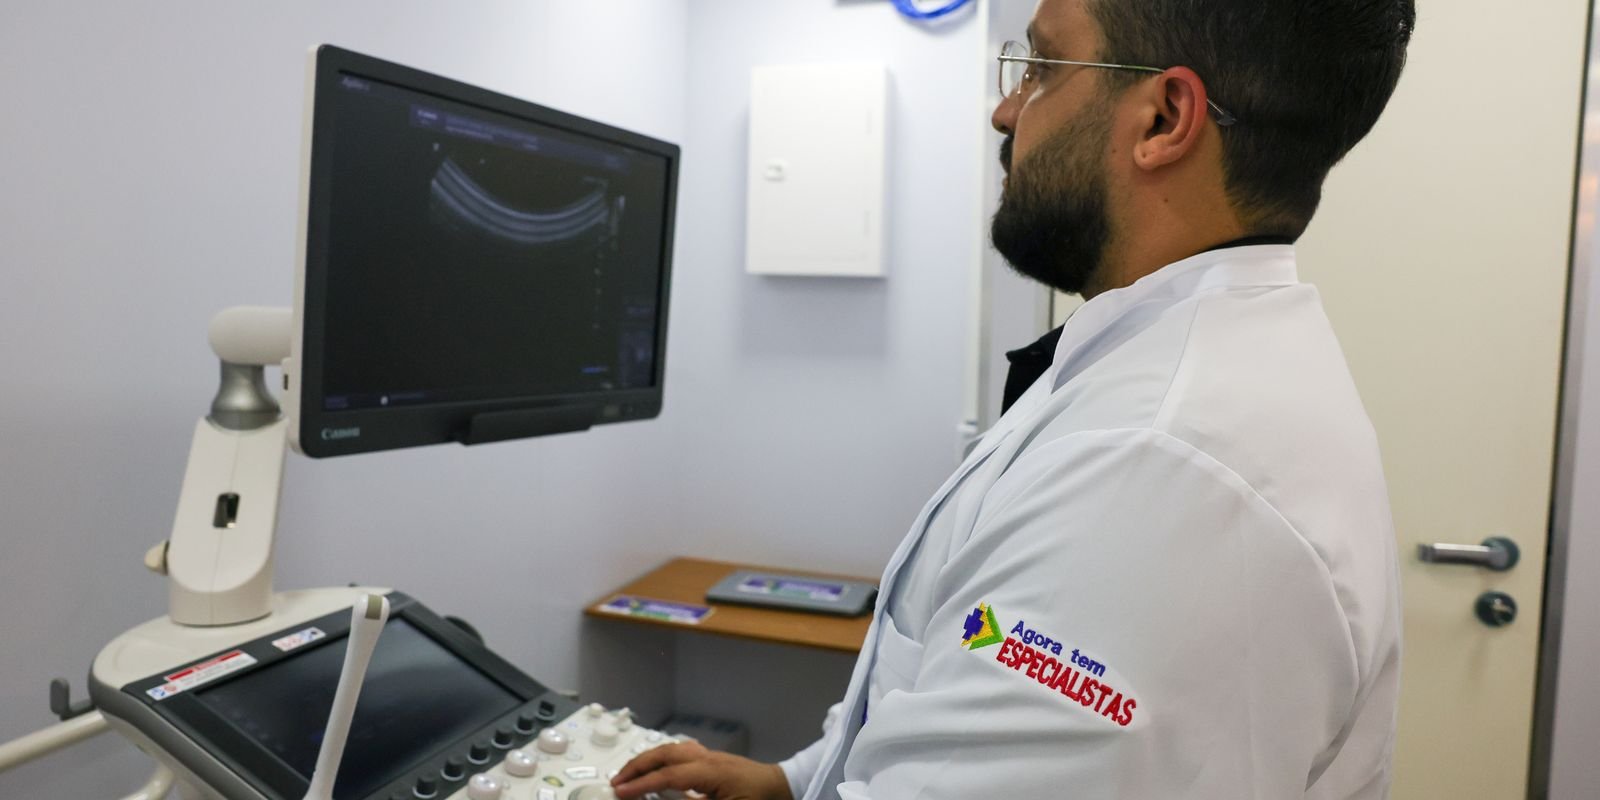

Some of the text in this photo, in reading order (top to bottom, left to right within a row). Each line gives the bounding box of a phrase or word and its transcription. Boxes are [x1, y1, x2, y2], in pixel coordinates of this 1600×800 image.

[321, 427, 360, 440] Canon
[1011, 620, 1106, 677] Agora tem
[996, 637, 1137, 727] ESPECIALISTAS
